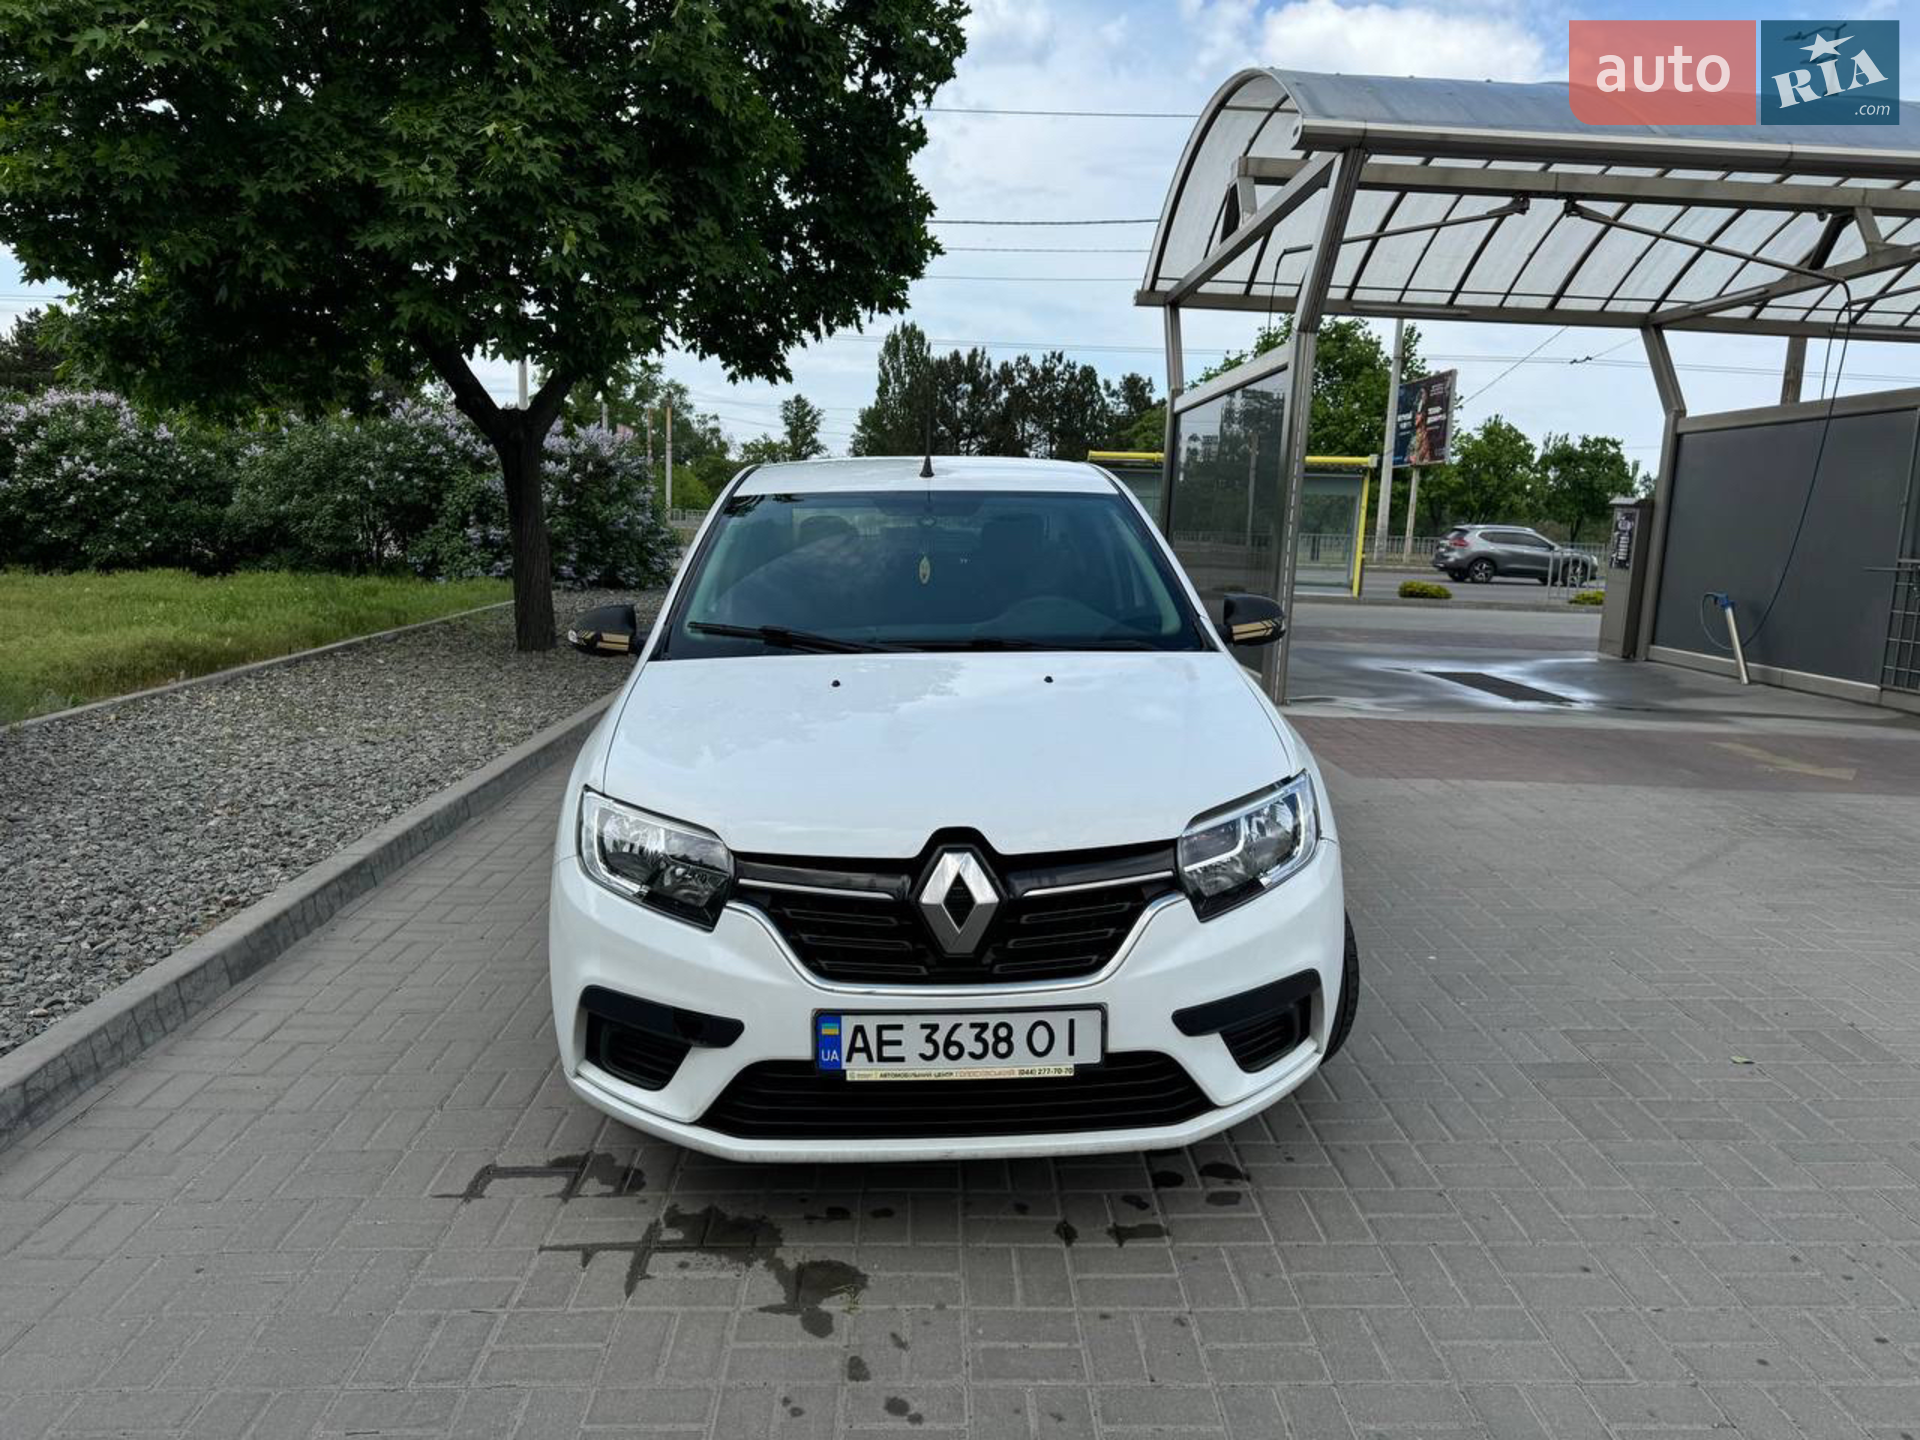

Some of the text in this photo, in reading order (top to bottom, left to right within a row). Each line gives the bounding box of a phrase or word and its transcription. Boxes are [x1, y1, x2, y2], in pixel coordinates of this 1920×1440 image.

[846, 1023, 906, 1063] AE
[918, 1021, 1014, 1061] 3638
[821, 1050, 840, 1062] UA
[1037, 1067, 1074, 1075] 277-70-70
